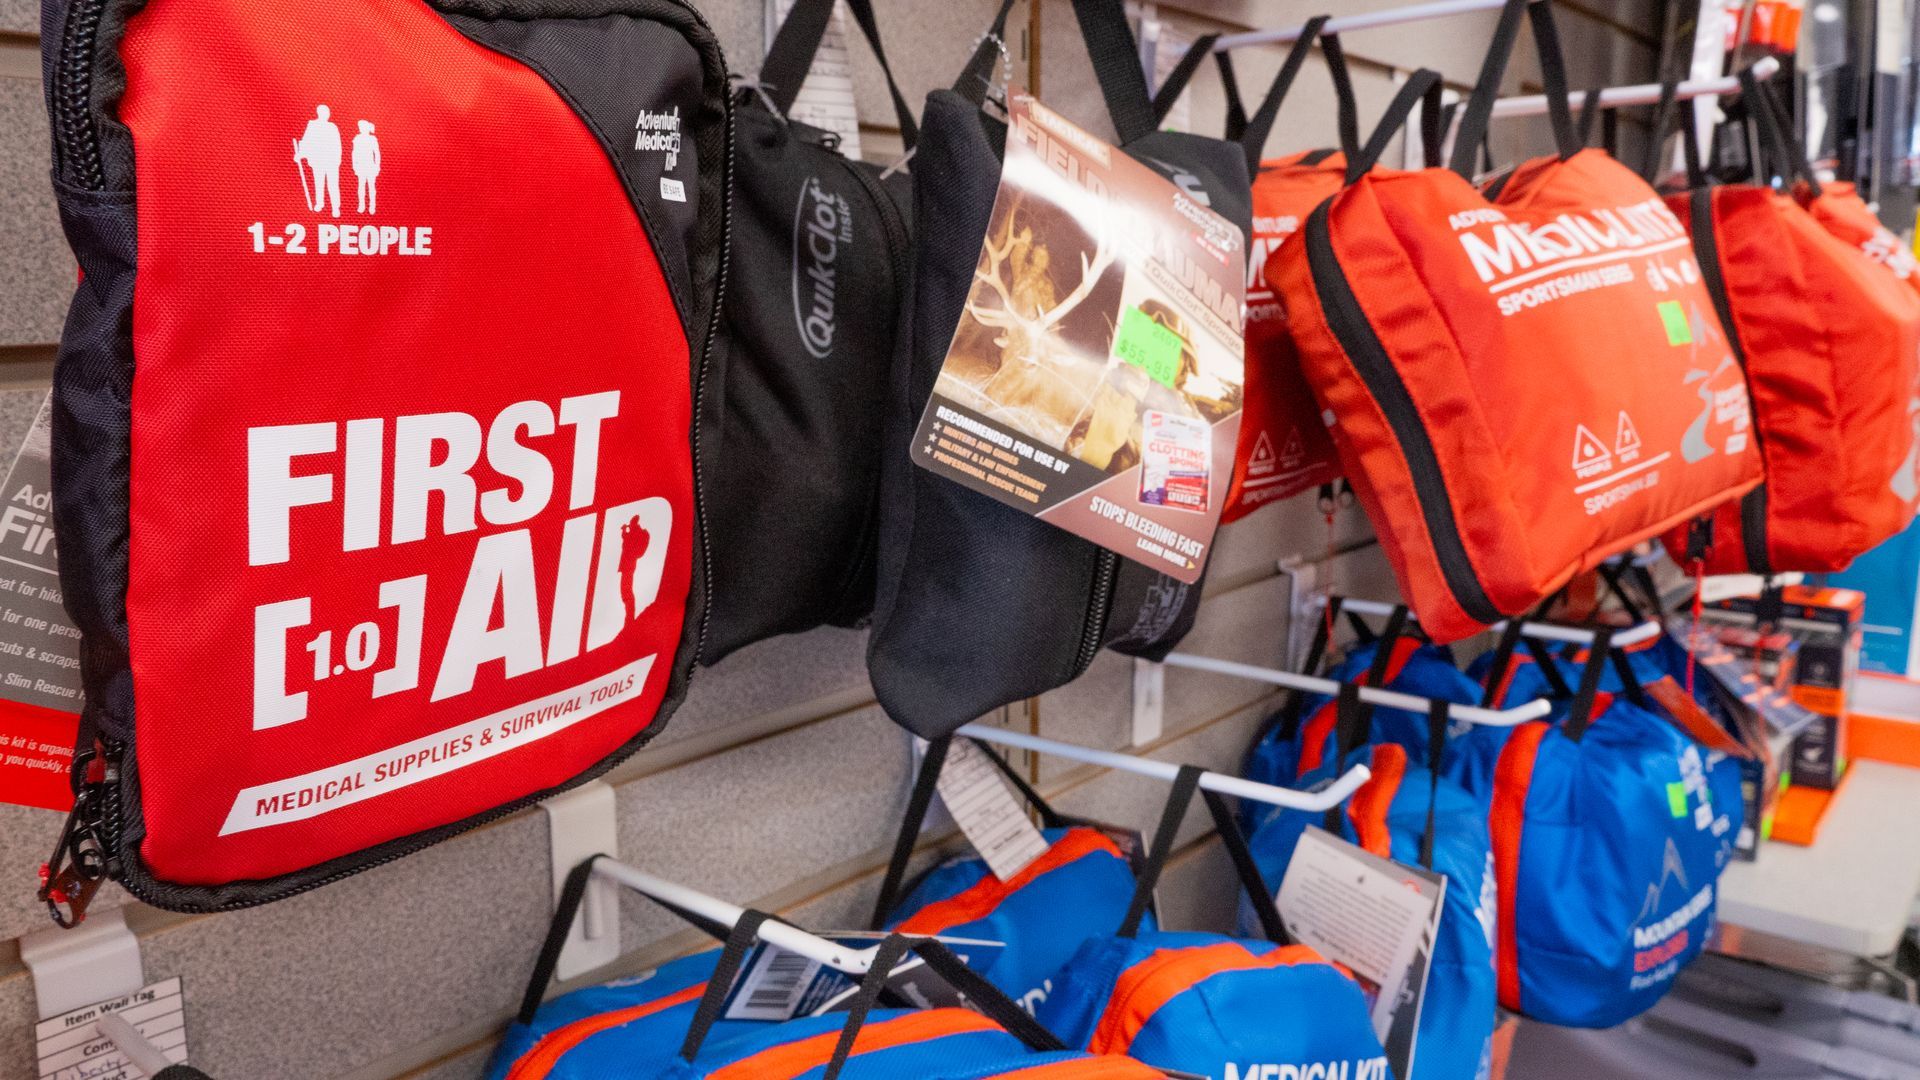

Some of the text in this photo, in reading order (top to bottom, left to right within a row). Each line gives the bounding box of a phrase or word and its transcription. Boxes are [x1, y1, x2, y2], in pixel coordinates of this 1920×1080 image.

[247, 222, 432, 256] 1-2 PEOPLE
[936, 405, 1070, 474] RECOMMENDED FOR USE BY
[248, 390, 621, 566] FIRST
[1090, 495, 1205, 559] STOPS BLEEDING FAST
[1136, 537, 1164, 557] LEARN
[17, 581, 38, 597] for
[430, 496, 674, 703] AID
[2, 608, 23, 624] for
[24, 617, 48, 631] one
[25, 647, 36, 659] &
[4, 672, 32, 688] Slim
[34, 678, 77, 698] Rescue
[11, 735, 26, 748] kit
[27, 739, 37, 750] is
[255, 674, 635, 816] MEDICAL SUPPLIES & SURVIVAL TOOLS
[4, 754, 26, 766] you
[25, 758, 63, 774] quickly,
[65, 988, 156, 1027] Item Wall Tag
